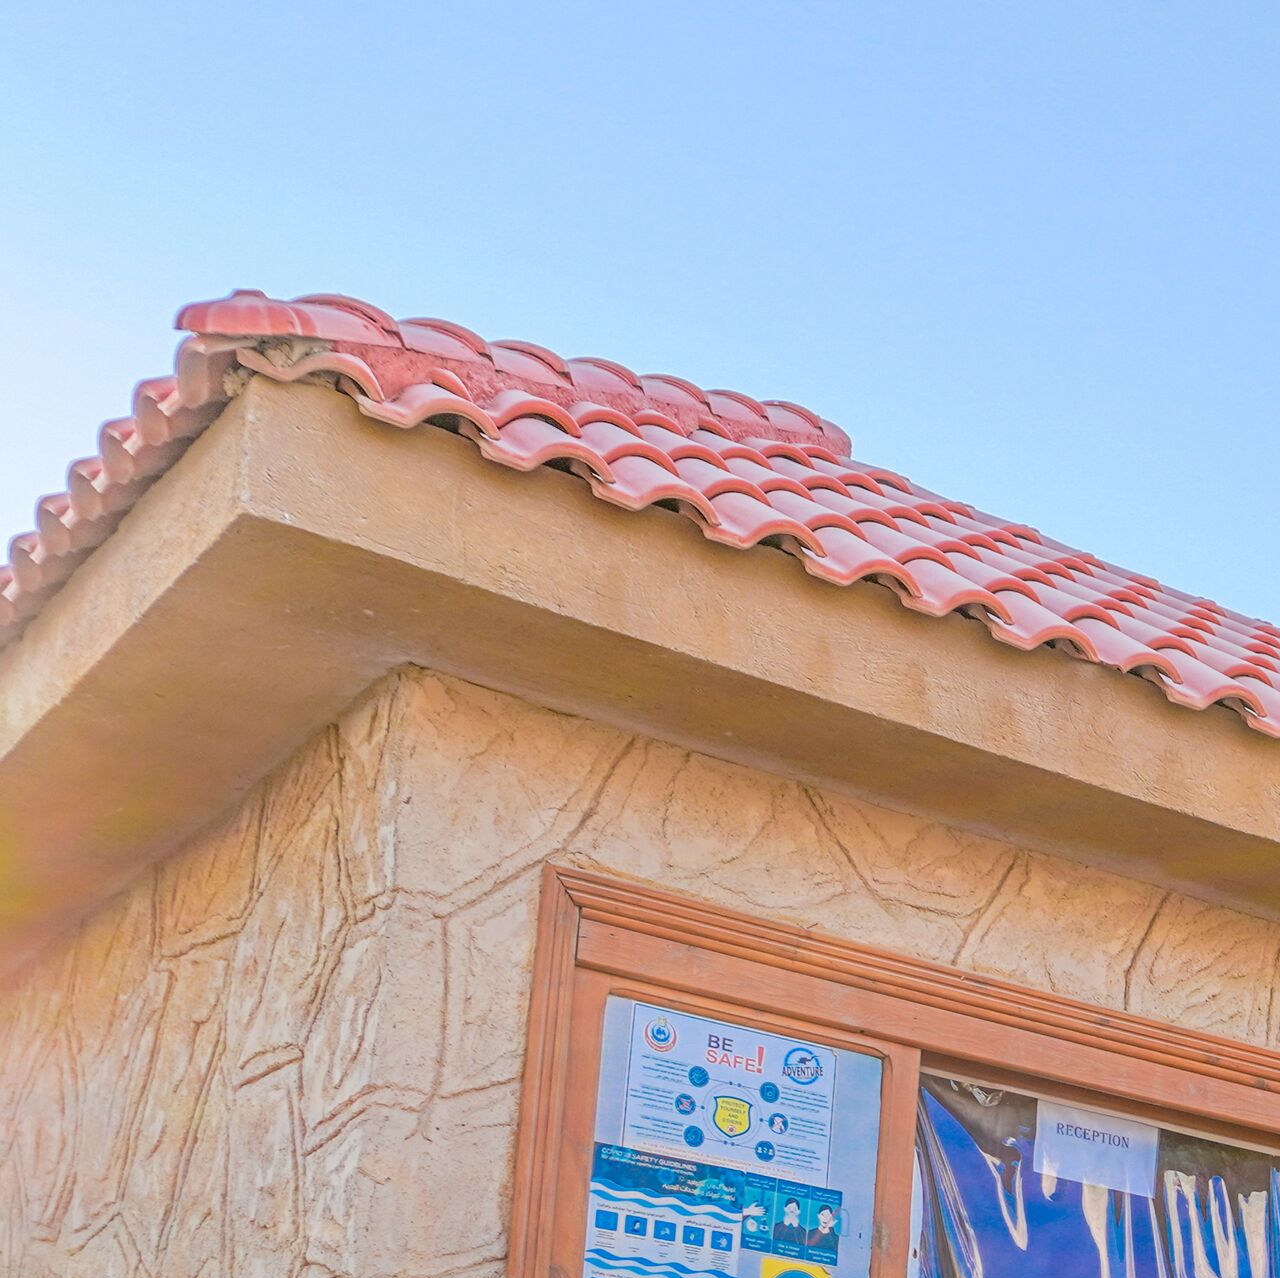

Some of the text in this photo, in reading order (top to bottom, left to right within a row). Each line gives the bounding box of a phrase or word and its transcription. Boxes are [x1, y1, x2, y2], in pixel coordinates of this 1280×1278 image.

[708, 1034, 733, 1052] BE
[706, 1046, 765, 1074] SAFE!
[782, 1066, 824, 1077] ADVENTURE
[1056, 1122, 1129, 1149] RECEPTION
[632, 1153, 658, 1164] SAFETY
